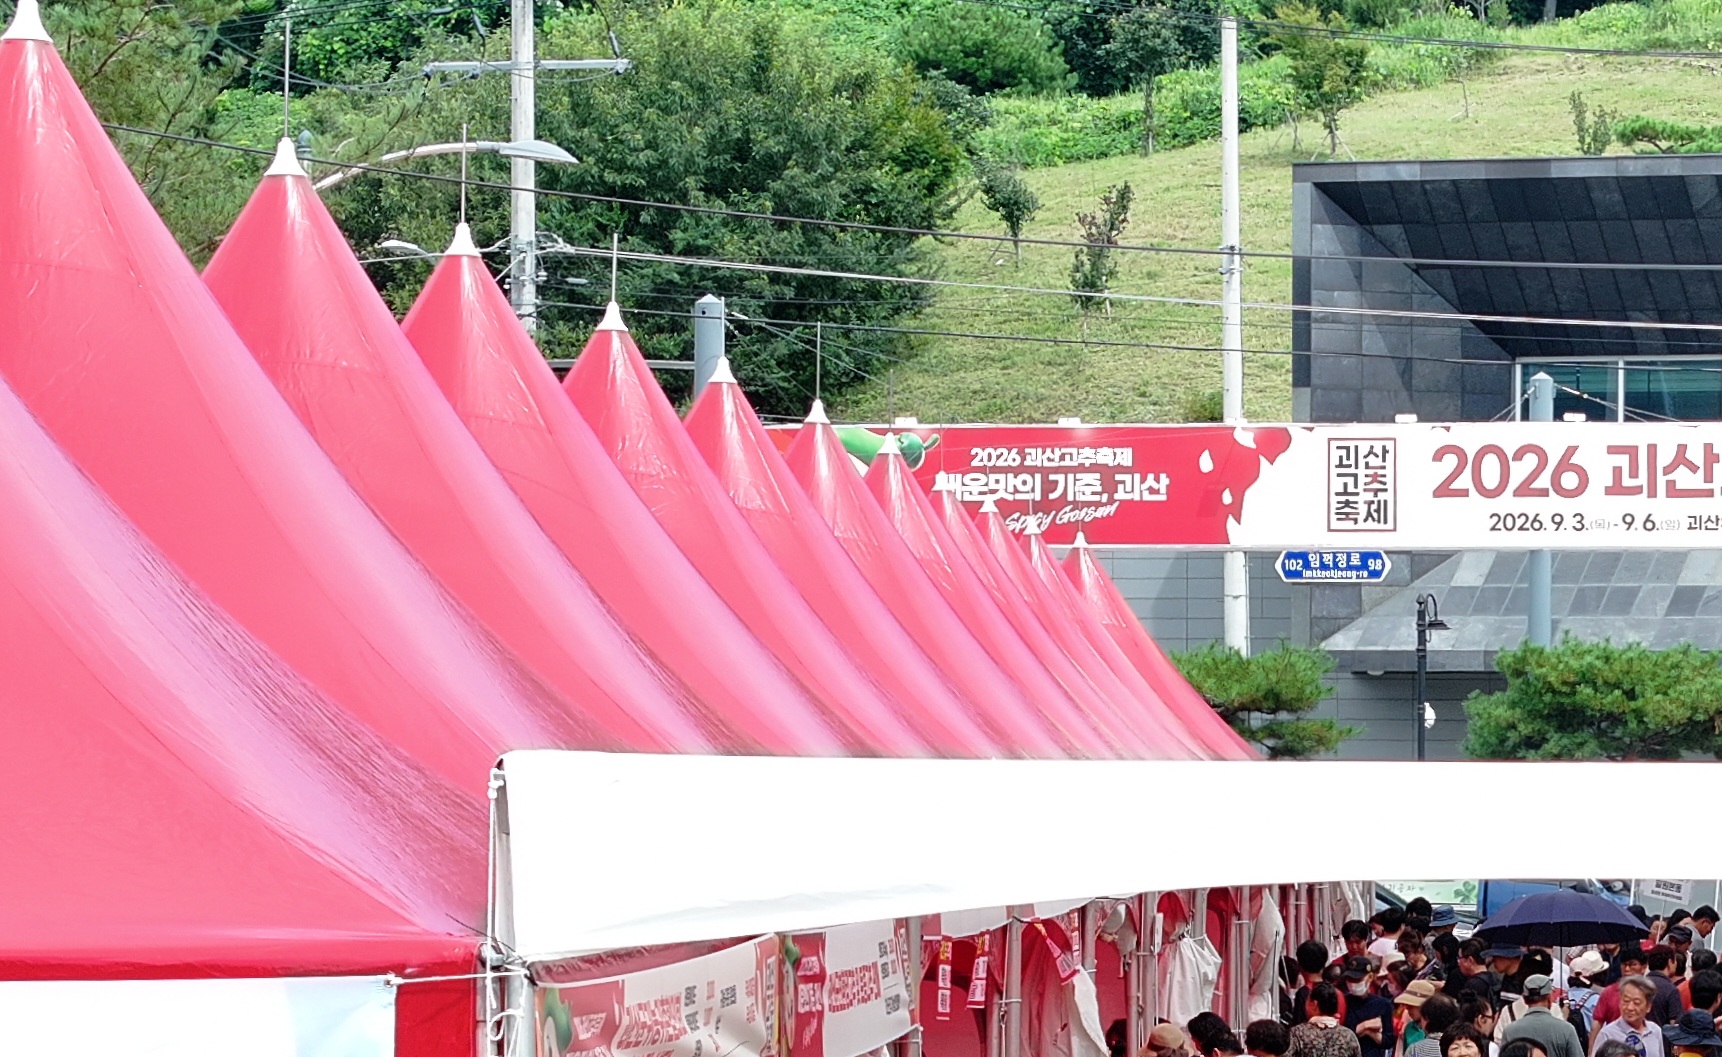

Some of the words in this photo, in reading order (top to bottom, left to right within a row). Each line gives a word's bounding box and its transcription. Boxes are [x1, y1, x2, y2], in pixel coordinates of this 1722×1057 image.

[970, 447, 1021, 467] 2026
[1023, 446, 1133, 467] 괴산고추축제
[1334, 444, 1389, 470] 괴산
[1431, 443, 1590, 499] 2026
[1048, 472, 1108, 503] 기준,
[1113, 473, 1170, 502] 괴산
[1334, 472, 1388, 498] 고추
[1334, 499, 1388, 525] 축제
[1284, 559, 1303, 571] 102
[1308, 553, 1362, 568] 임꺽정로
[1368, 559, 1383, 571] 98
